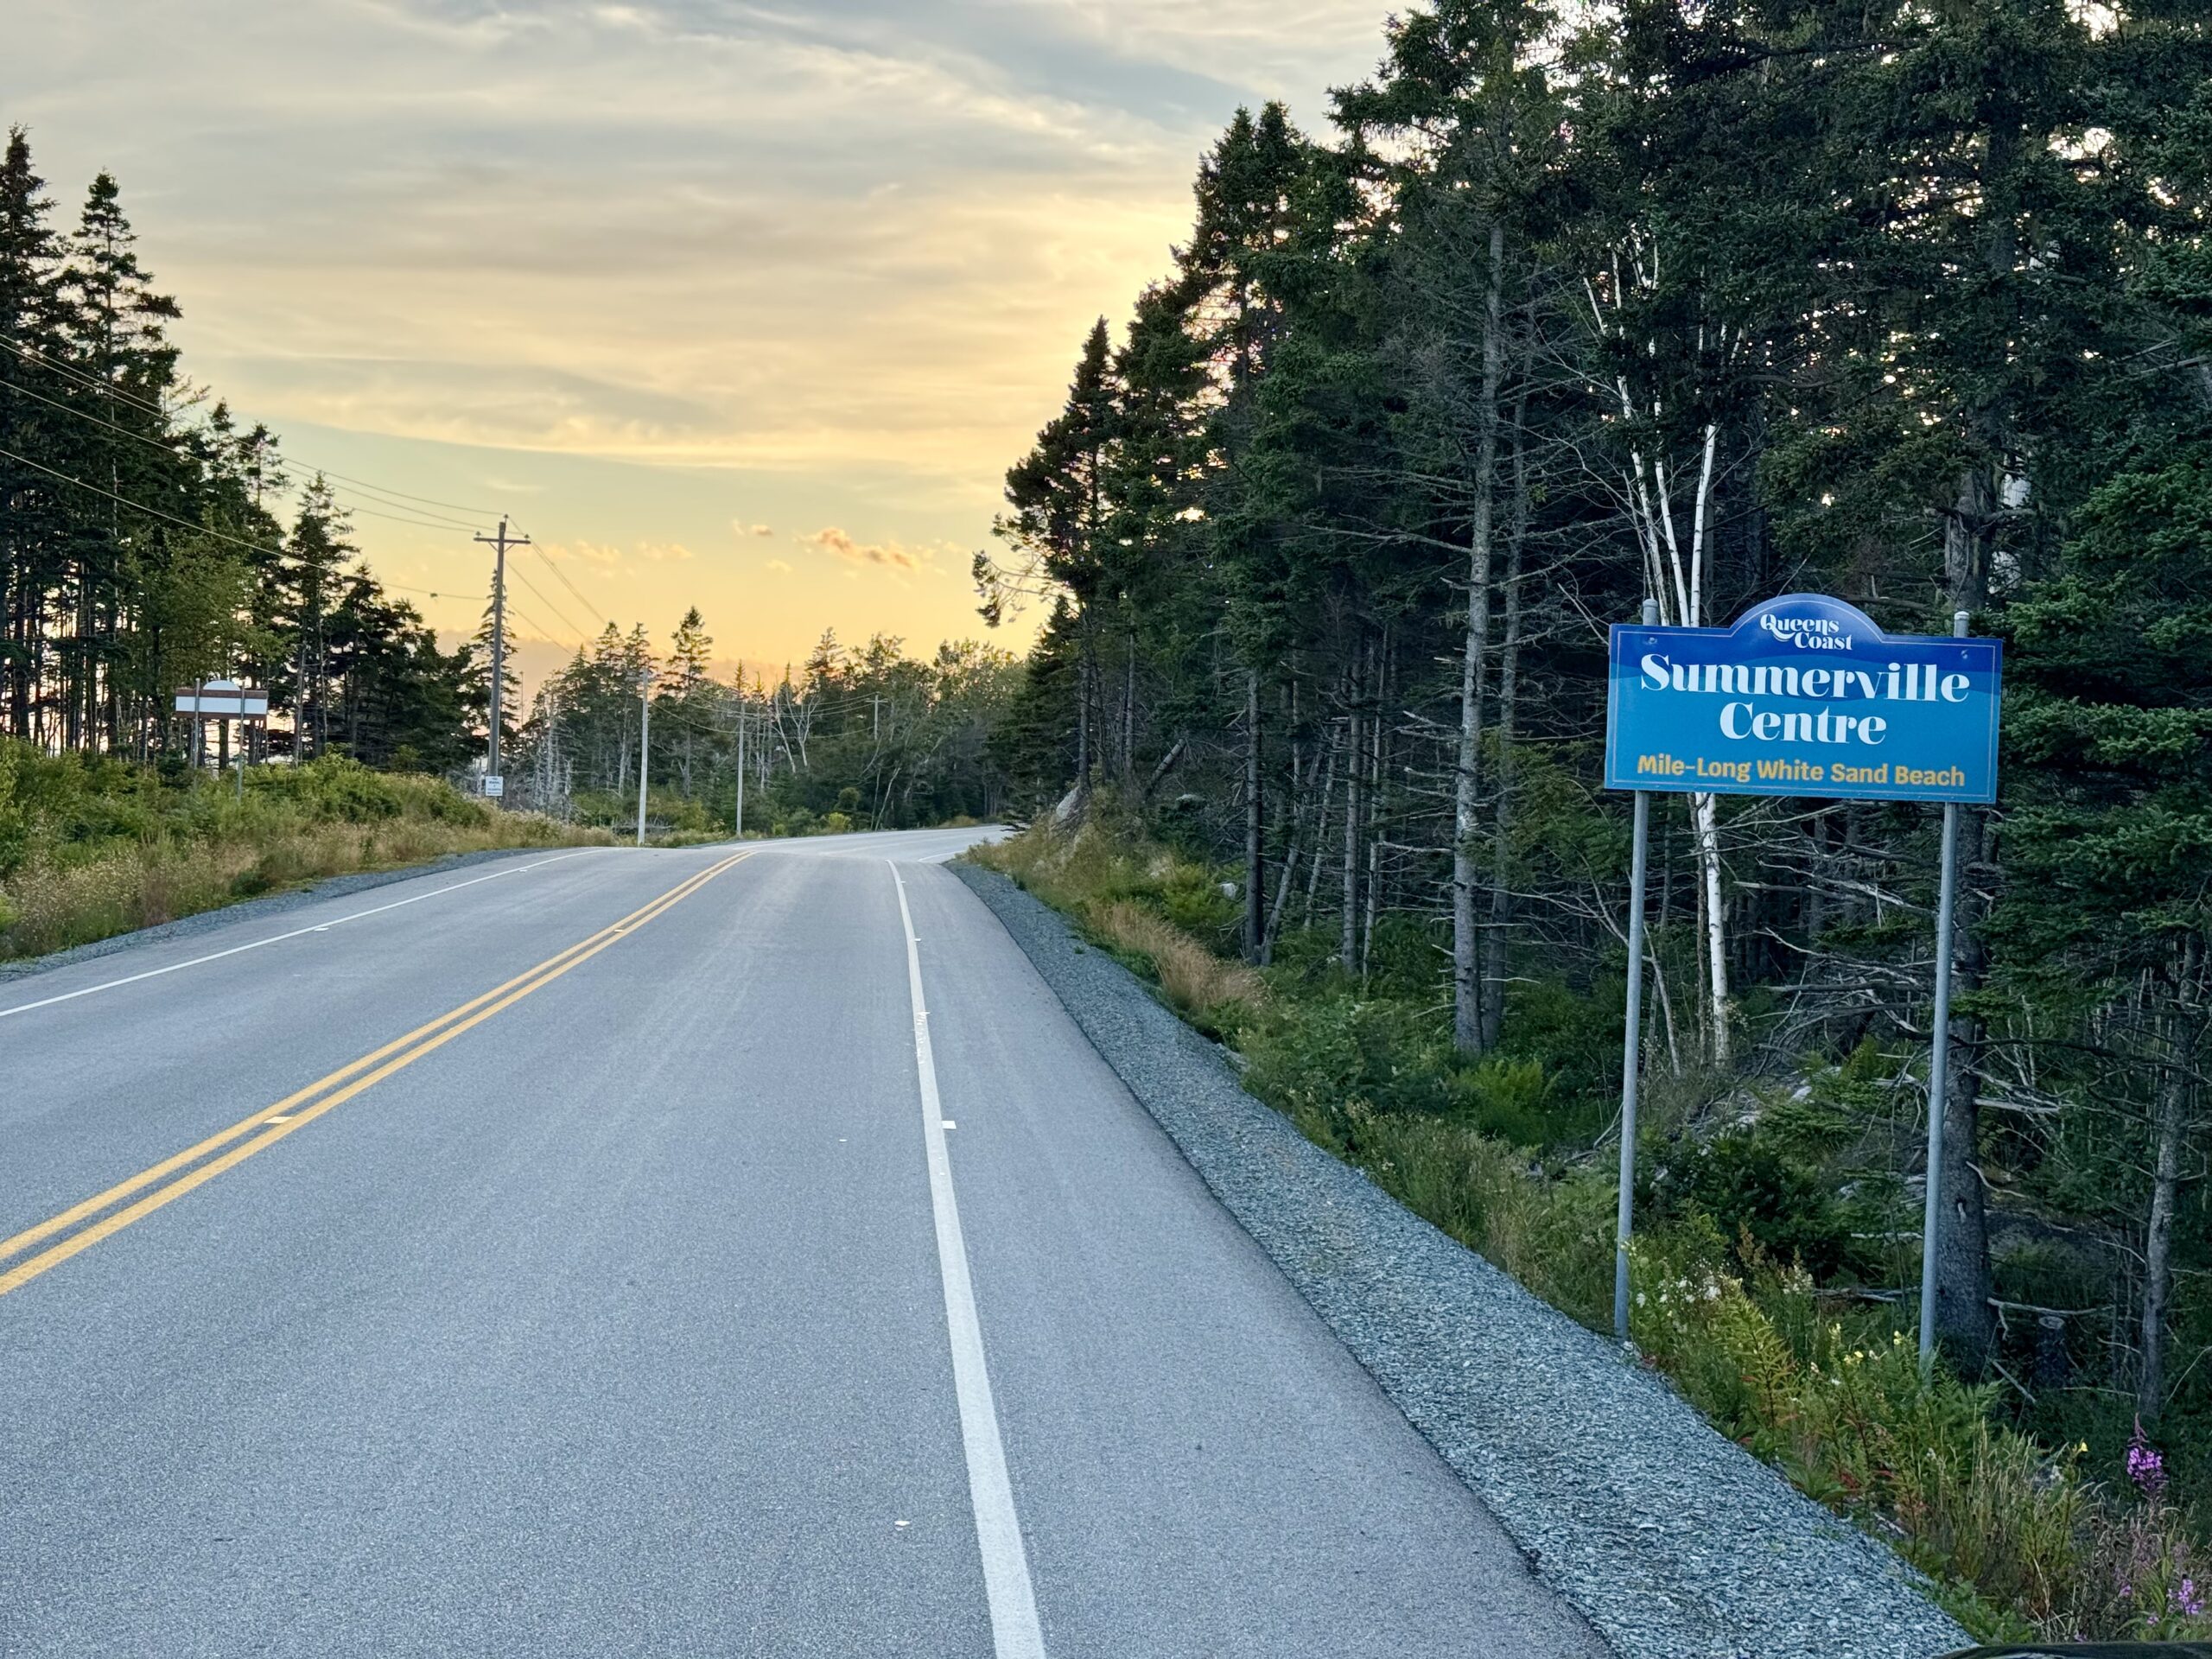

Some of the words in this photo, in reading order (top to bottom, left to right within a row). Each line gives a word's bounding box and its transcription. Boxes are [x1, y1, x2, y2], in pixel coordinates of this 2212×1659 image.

[1760, 613, 1840, 640] Queens
[1795, 632, 1853, 650] Coast
[1641, 653, 1970, 703] Summerville
[1719, 702, 1887, 745] Centre
[1637, 753, 1751, 783] Mile-Long
[1758, 759, 1824, 783] White
[1831, 763, 1888, 785] Sand
[1895, 766, 1965, 786] Beach
